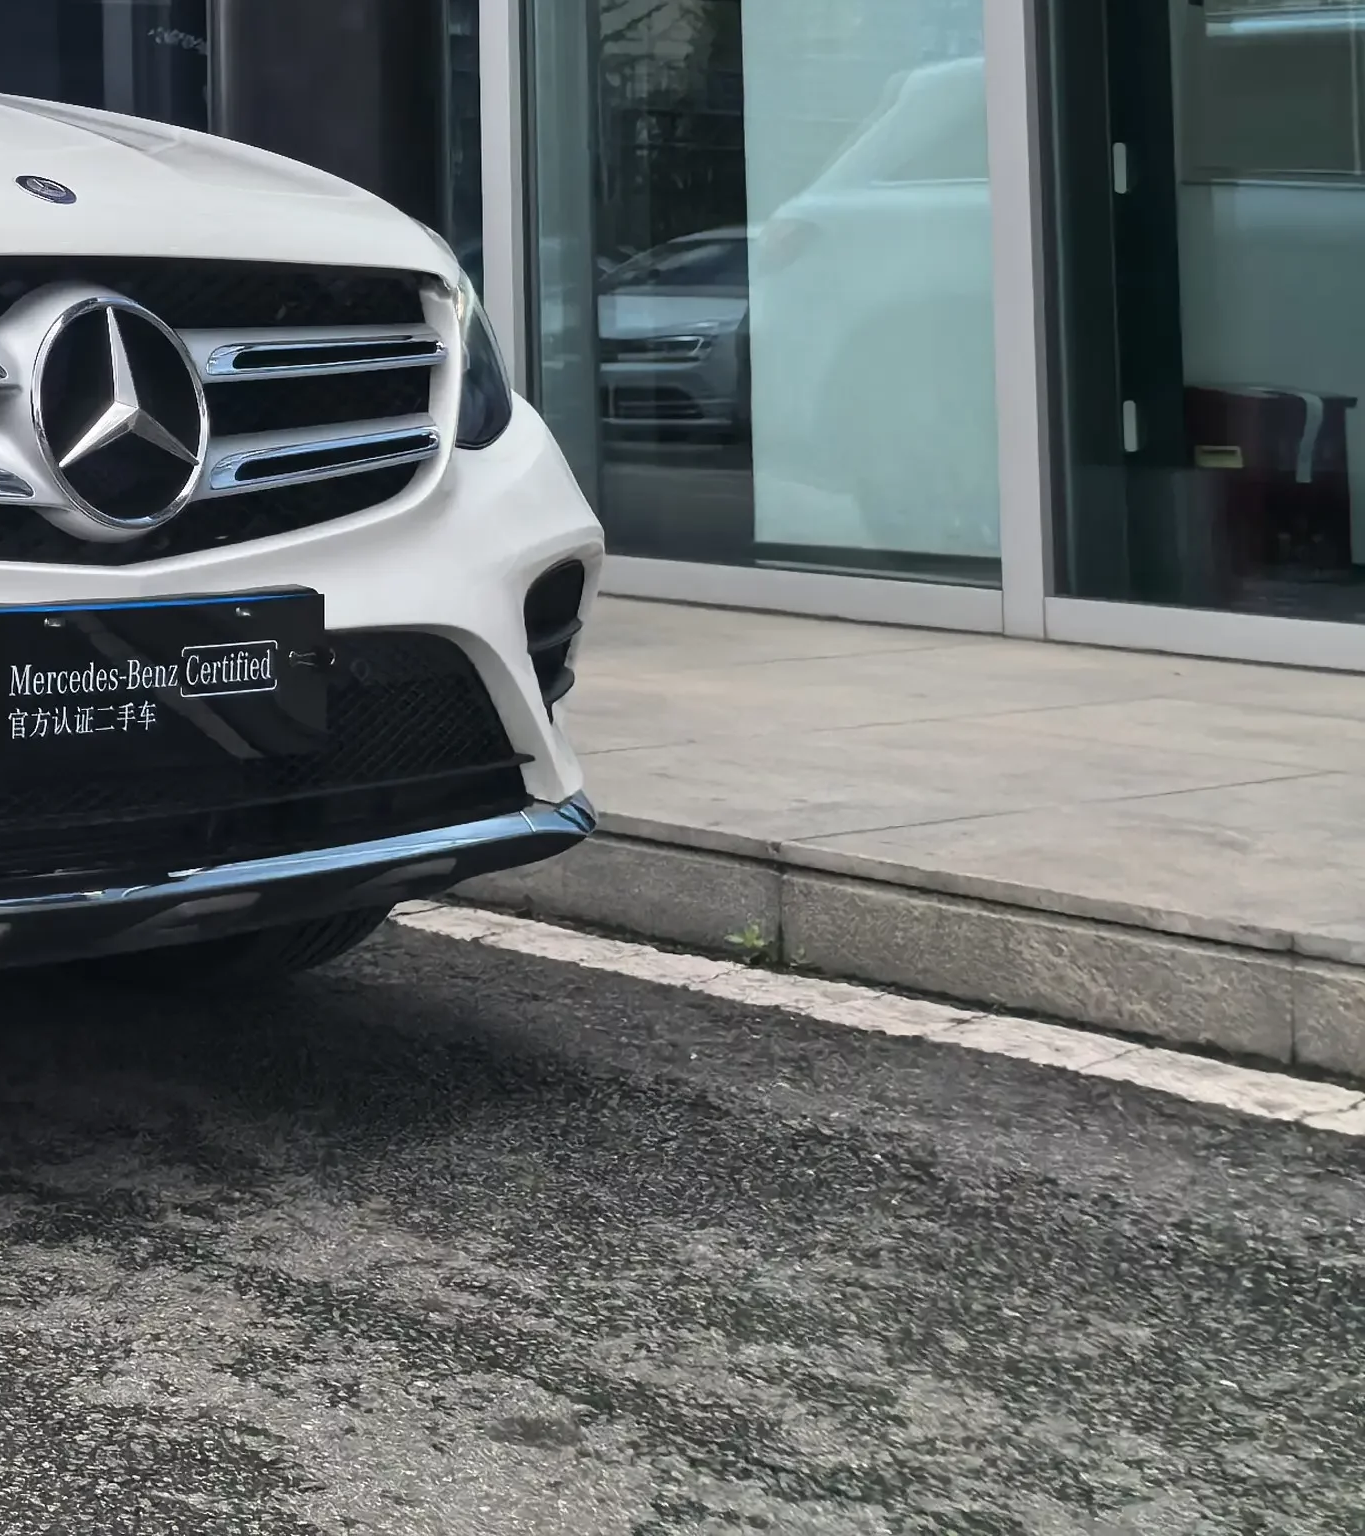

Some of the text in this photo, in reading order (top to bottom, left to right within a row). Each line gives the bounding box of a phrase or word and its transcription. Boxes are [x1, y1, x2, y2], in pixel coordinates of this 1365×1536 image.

[9, 649, 271, 697] Mercedes-Benz Certified
[8, 700, 156, 739] 官方认证二手车
